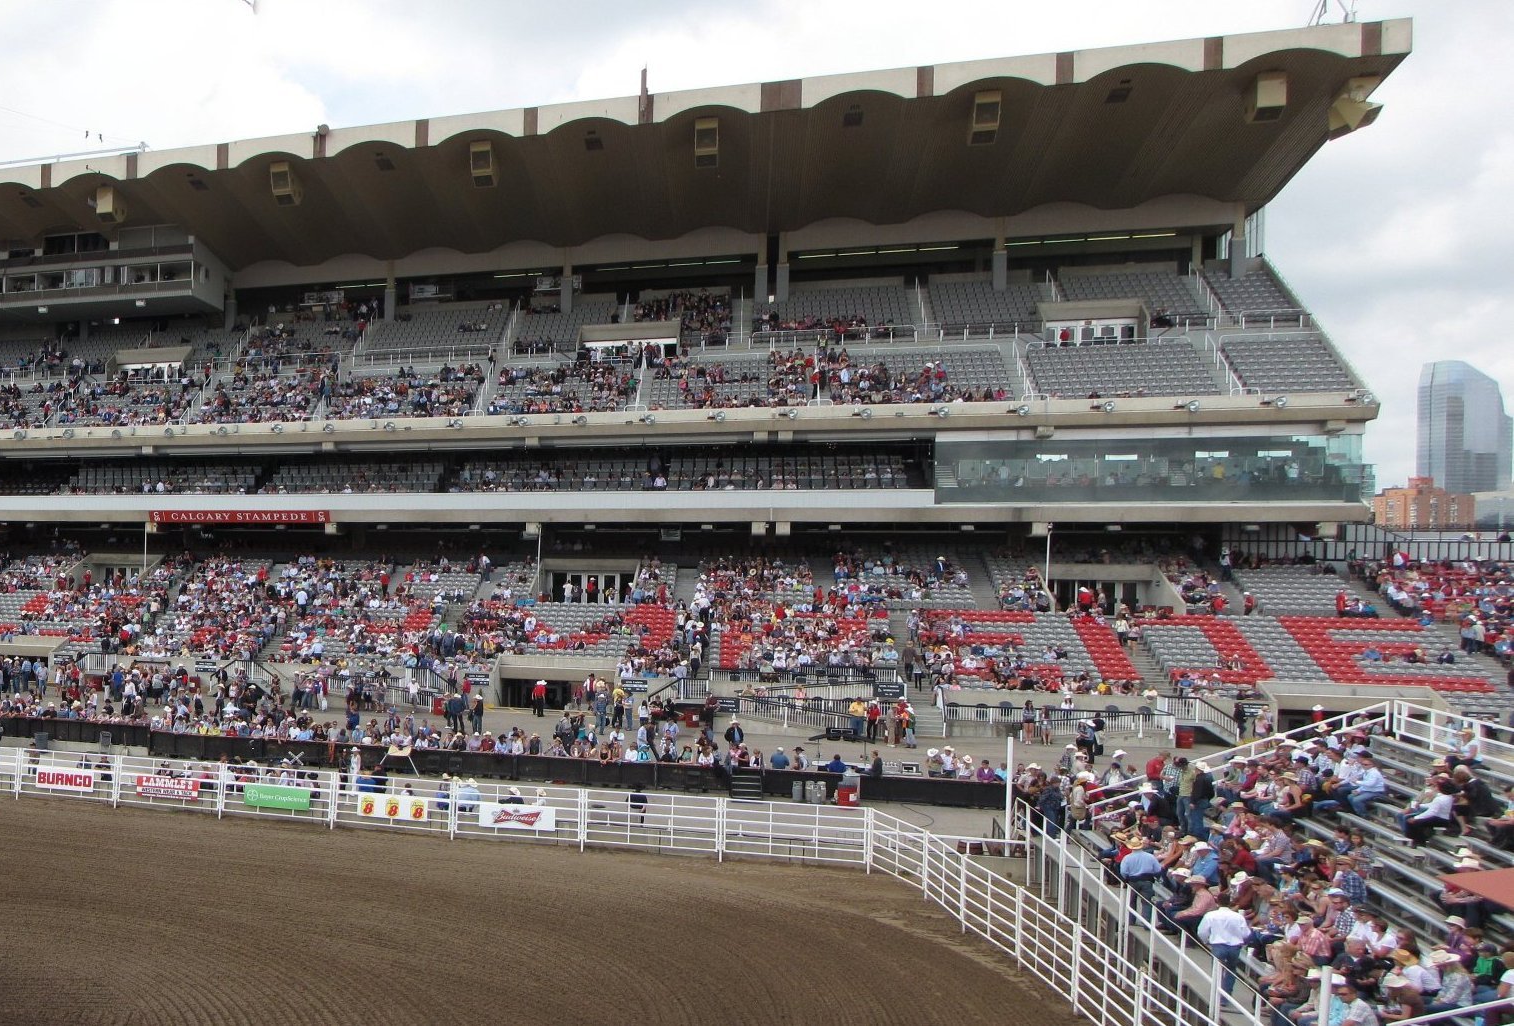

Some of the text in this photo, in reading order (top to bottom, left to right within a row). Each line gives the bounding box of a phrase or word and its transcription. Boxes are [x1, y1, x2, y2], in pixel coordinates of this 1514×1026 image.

[171, 512, 308, 521] CALGARY STAMPEDE
[37, 771, 93, 788] BURNCO
[274, 793, 308, 803] CropScience
[363, 803, 374, 814] 8
[388, 805, 399, 816] 8
[412, 807, 423, 818] 8
[493, 811, 542, 824] Budweiser
